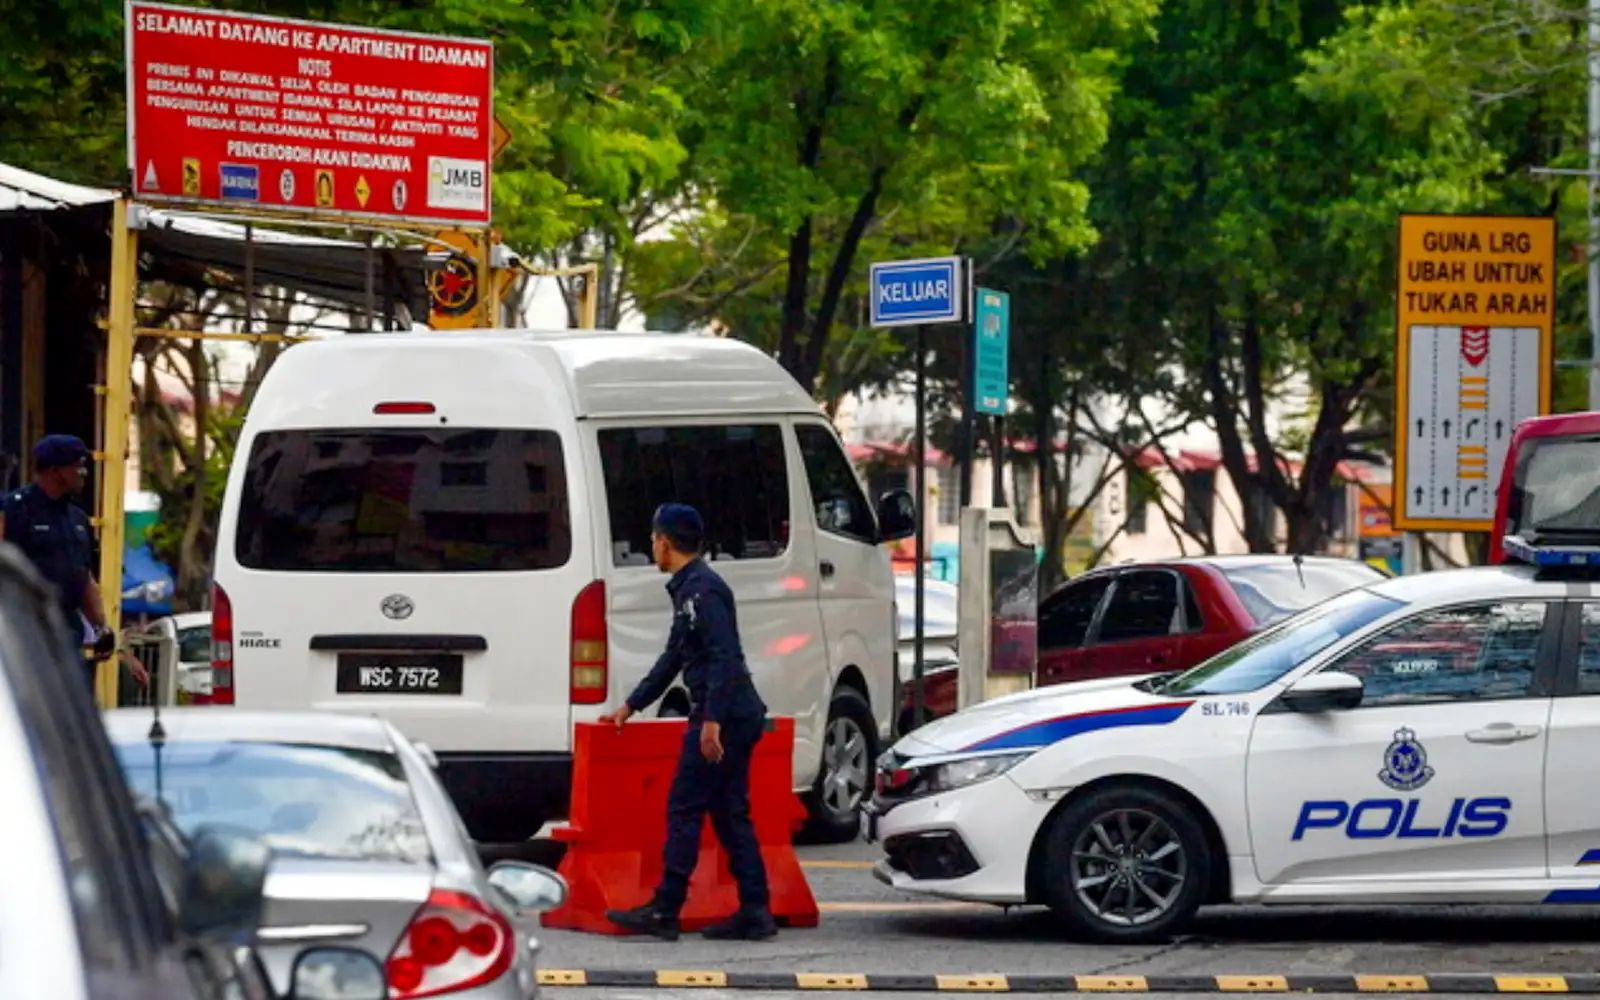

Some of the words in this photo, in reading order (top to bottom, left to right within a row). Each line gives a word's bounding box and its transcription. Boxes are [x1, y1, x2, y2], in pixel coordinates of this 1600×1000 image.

[137, 14, 215, 37] SELAMAT
[220, 23, 289, 46] DATANG
[294, 31, 313, 49] KE
[317, 34, 416, 60] APARTMENT
[419, 46, 487, 69] IDAMAN
[298, 58, 332, 77] NOTIS
[147, 62, 190, 78] PREMIS
[196, 68, 214, 80] INI
[220, 71, 275, 87] DIKAWAL
[317, 81, 350, 95] OLEH
[355, 86, 397, 100] BADAN
[402, 90, 480, 109] PENGURUSAN
[147, 78, 204, 96] BERSAMA
[208, 85, 280, 104] APARTMENT
[338, 99, 363, 112] SILA
[366, 102, 405, 117] LAPOR
[408, 106, 424, 118] KE
[427, 107, 478, 124] PEJABAT
[147, 95, 229, 115] PENGURUSAN
[235, 104, 277, 119] UNTUK
[281, 109, 322, 124] SEMUA
[327, 114, 375, 129] URUSAN
[391, 119, 443, 136] AKTIVITI
[447, 125, 479, 140] YANG
[187, 116, 237, 132] HENDAK
[335, 130, 378, 145] TERIMA
[378, 134, 415, 149] KASIH
[227, 140, 313, 164] PENCEROBOH
[313, 148, 351, 167] AKAN
[351, 151, 412, 173] DIDAKWA
[442, 168, 481, 187] JMB
[1423, 231, 1481, 252] GUNA
[1489, 232, 1531, 253] LRG
[1408, 260, 1465, 282] UBAH
[1474, 261, 1544, 283] UNTUK
[880, 280, 947, 303] KELUAR
[1406, 292, 1478, 313] TUKAR
[1486, 293, 1547, 314] ARAH
[240, 638, 281, 648] HIACE
[359, 667, 392, 686] WSC
[399, 667, 439, 687] 7572
[1201, 702, 1225, 716] SL
[1292, 797, 1512, 841] POLIS
